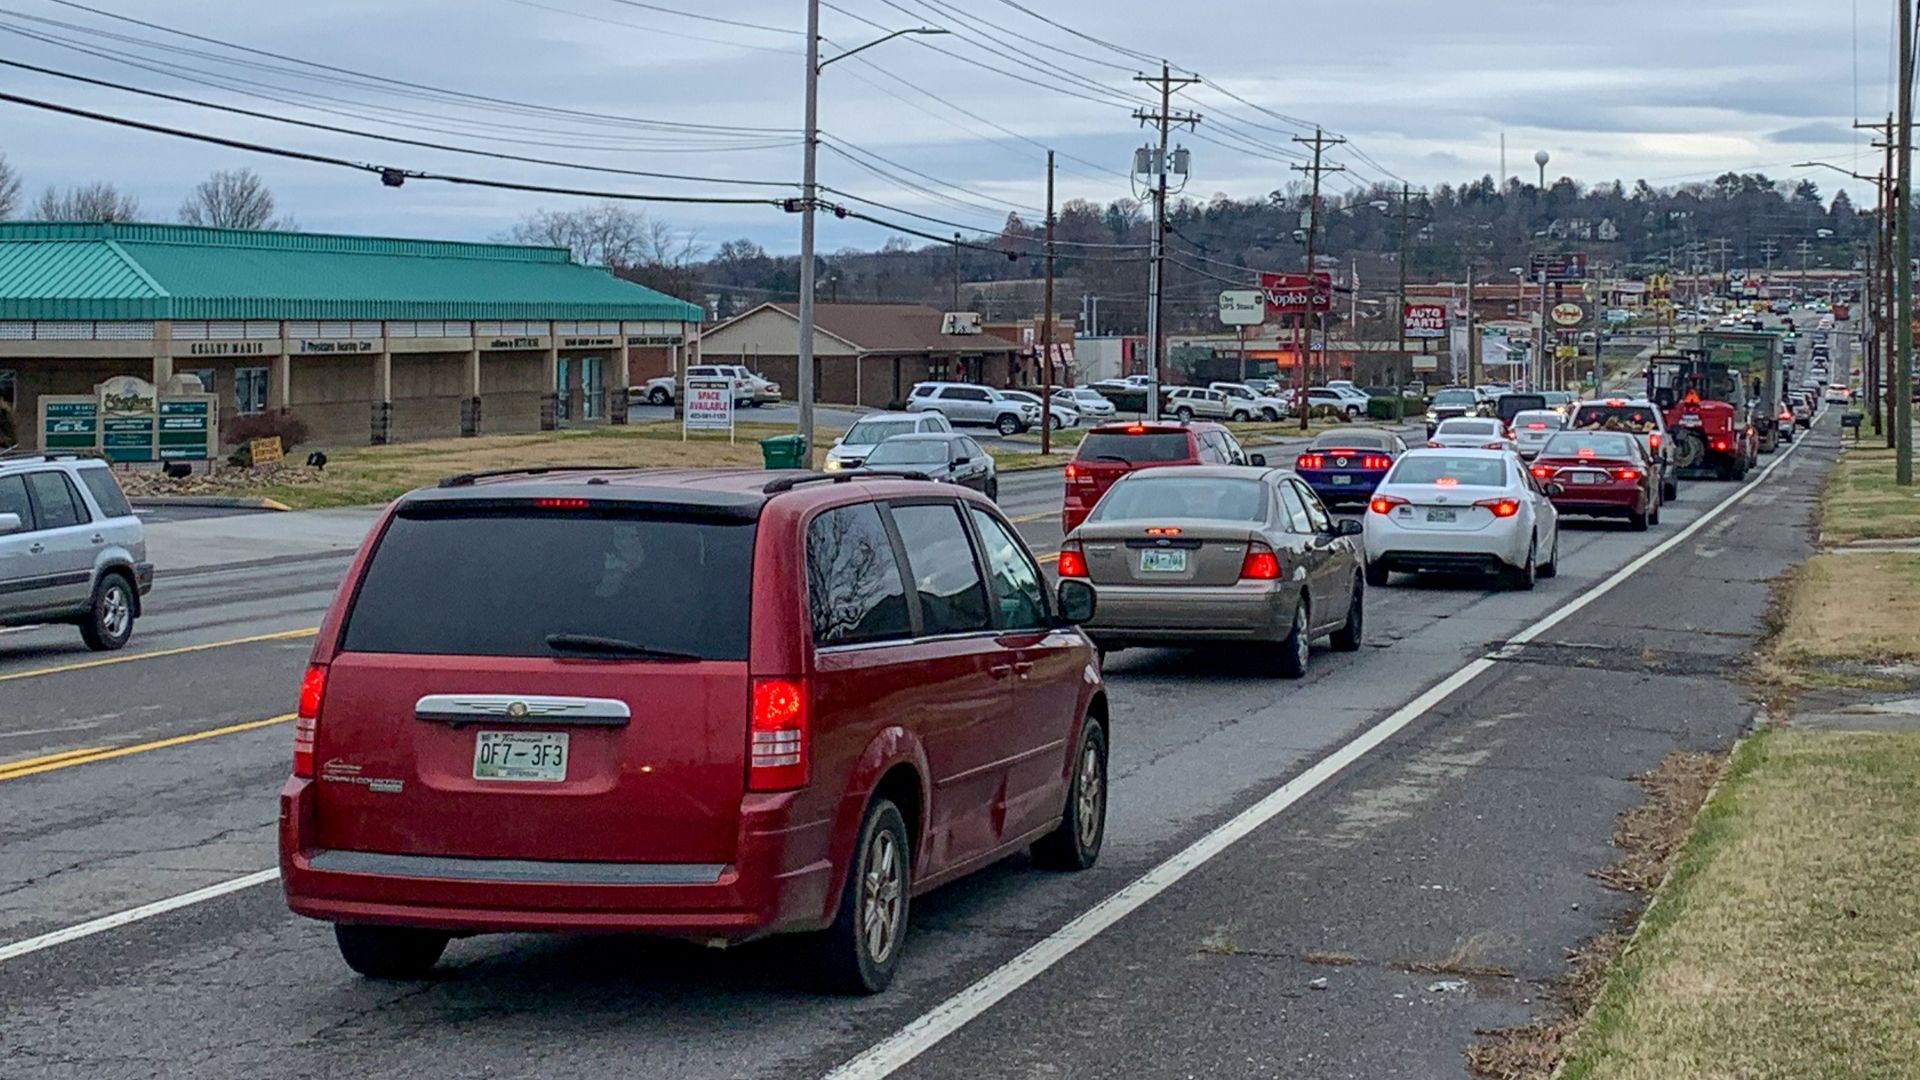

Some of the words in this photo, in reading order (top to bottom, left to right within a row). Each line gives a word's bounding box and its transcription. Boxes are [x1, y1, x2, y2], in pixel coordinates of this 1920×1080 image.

[1410, 308, 1441, 318] AUTO
[1406, 318, 1443, 328] PARTS
[191, 343, 228, 354] KELLEY
[232, 342, 263, 353] MARIE
[697, 391, 720, 400] SPACE
[689, 402, 727, 410] AVAILABLE
